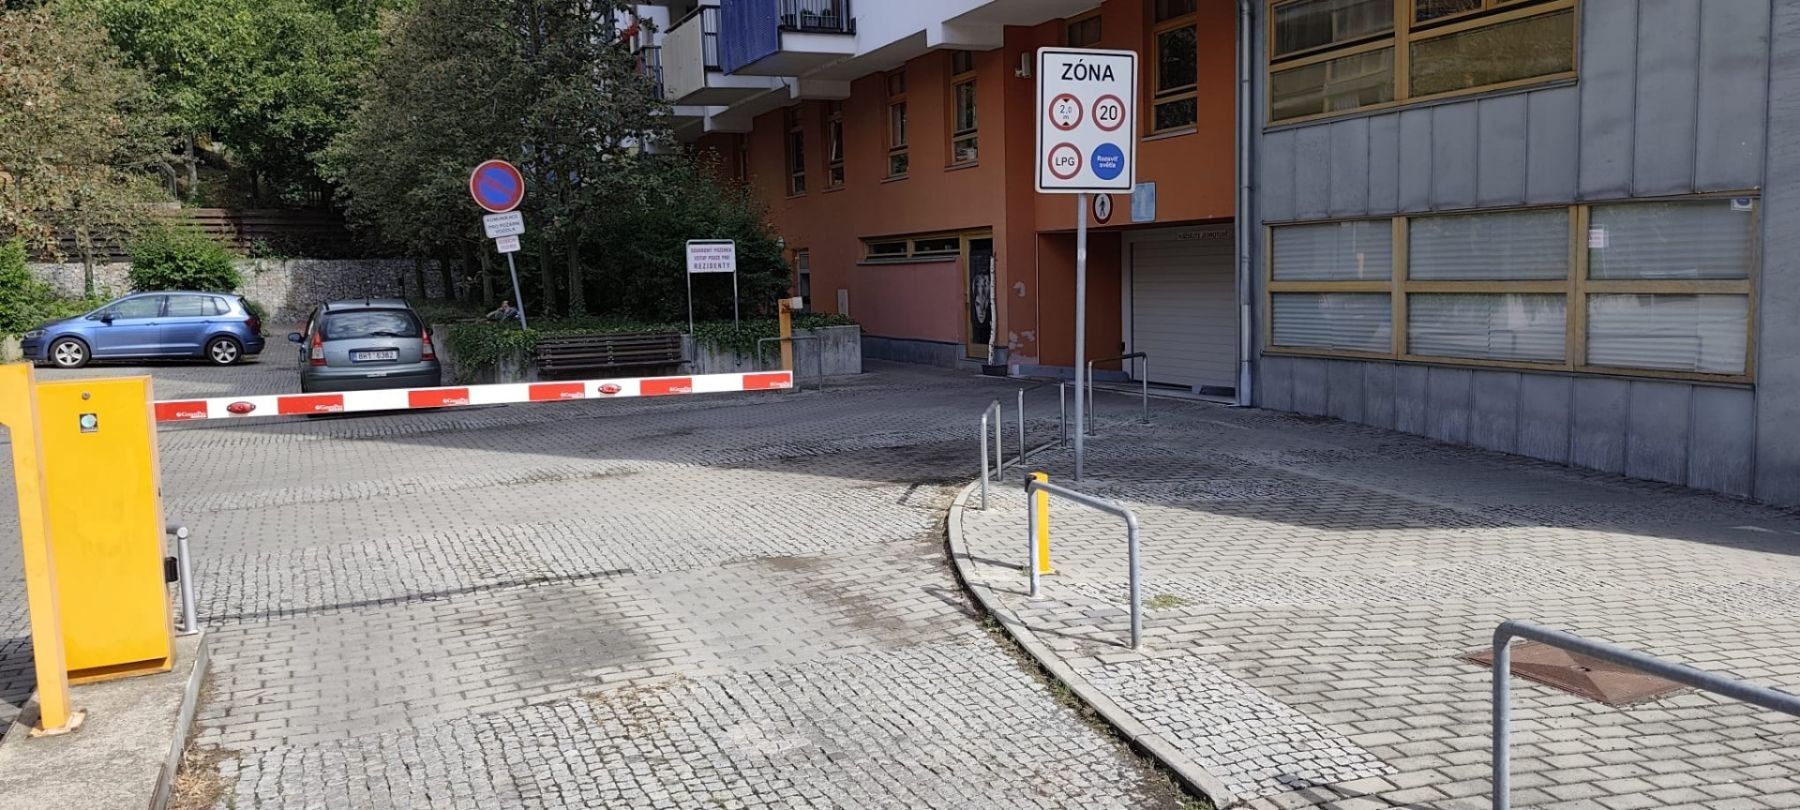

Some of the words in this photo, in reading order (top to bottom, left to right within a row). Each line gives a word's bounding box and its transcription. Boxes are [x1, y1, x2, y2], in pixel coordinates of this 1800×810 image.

[1061, 59, 1115, 82] ZÓNA
[1099, 105, 1118, 121] 20
[1055, 156, 1075, 167] LPG
